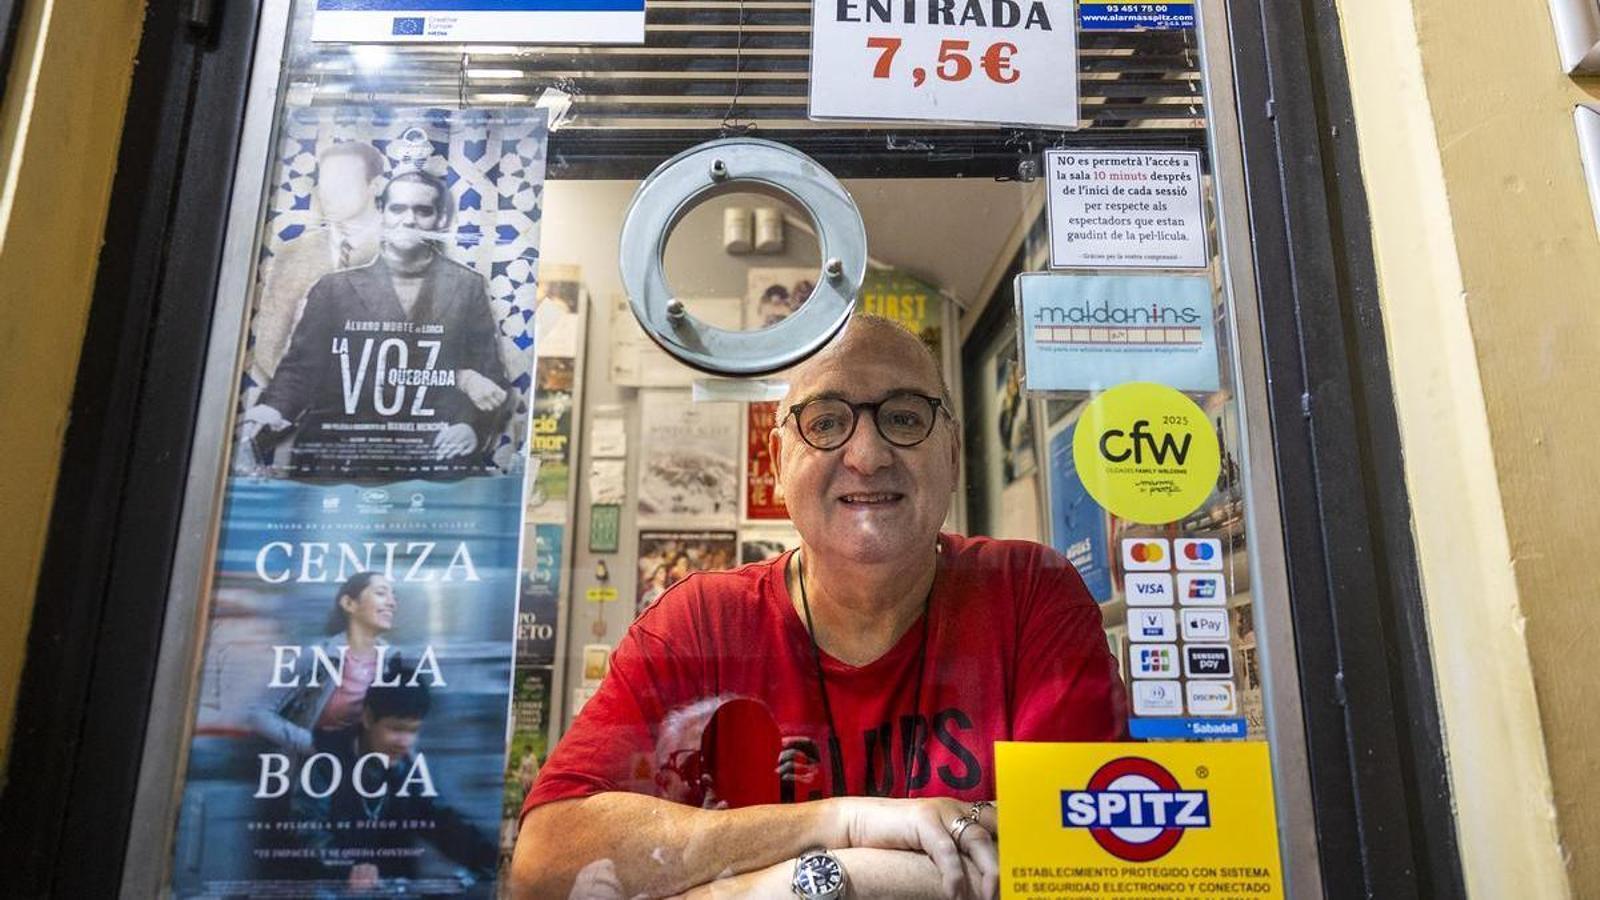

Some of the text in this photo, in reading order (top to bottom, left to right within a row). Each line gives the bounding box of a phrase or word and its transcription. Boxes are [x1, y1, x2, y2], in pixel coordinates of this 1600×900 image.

[836, 0, 1053, 31] ENTRADA
[866, 37, 1021, 88] 7,5€
[1057, 156, 1075, 166] NO
[1078, 158, 1089, 166] es
[1092, 156, 1142, 168] permetrà
[1183, 159, 1189, 167] a
[1056, 171, 1192, 184] la sala 10 minuts després
[1062, 186, 1076, 195] de
[1112, 186, 1126, 196] de
[1127, 186, 1153, 196] cada
[1155, 186, 1188, 197] sessió
[1084, 201, 1168, 214] per respecte als
[1068, 216, 1185, 229] espectadors que estan
[1067, 230, 1107, 243] gaudint
[1110, 230, 1123, 240] de
[1125, 230, 1136, 240] la
[1036, 300, 1200, 323] maldanins
[331, 337, 349, 354] LA
[340, 337, 442, 416] VOZ
[388, 368, 456, 387] QUEBRADA
[1162, 415, 1189, 426] 2025
[1099, 420, 1193, 466] cfw
[254, 541, 481, 583] CENIZA
[1136, 583, 1165, 594] VISA
[1201, 619, 1221, 631] Pay
[267, 645, 447, 688] EN LA
[1200, 660, 1219, 670] pay
[1193, 723, 1239, 734] Sabadell
[253, 752, 438, 799] BOCA
[1066, 792, 1206, 826] SPITZ
[1012, 867, 1270, 878] ESTABLECIMIENTO PROTEGIDO CON SISTEMA
[1014, 882, 1271, 893] DE SEGURIDAD ELECTRONICO Y CONECTADO
